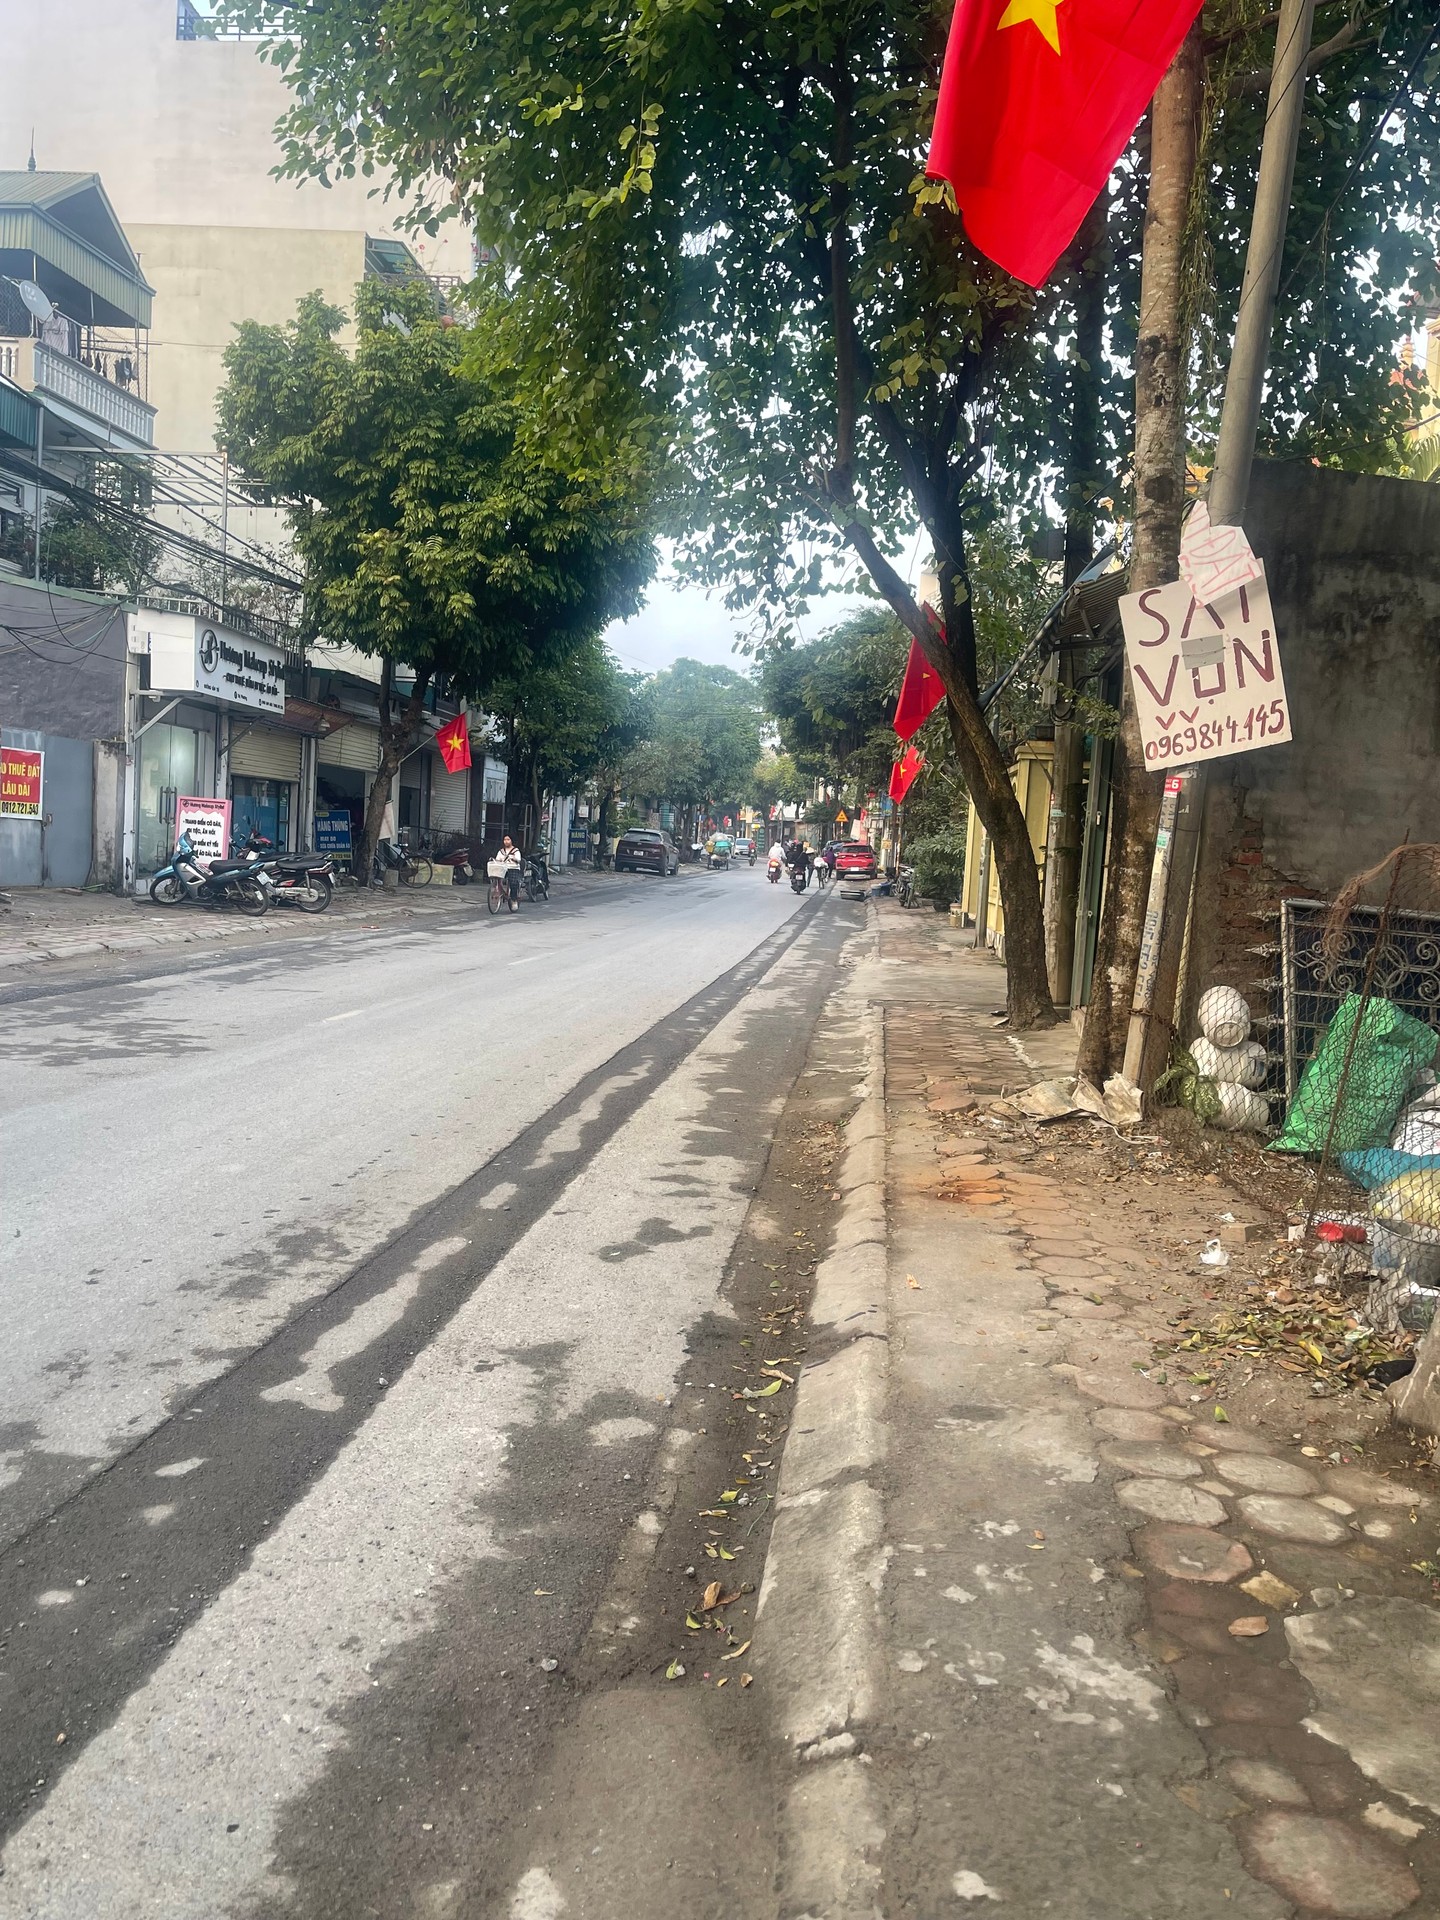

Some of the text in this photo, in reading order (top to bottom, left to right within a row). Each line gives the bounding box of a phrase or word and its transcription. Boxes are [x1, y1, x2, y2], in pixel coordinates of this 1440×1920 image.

[8, 761, 26, 776] THUÊ
[27, 762, 41, 778] ĐẤT
[2, 780, 31, 796] LÂU DÀI
